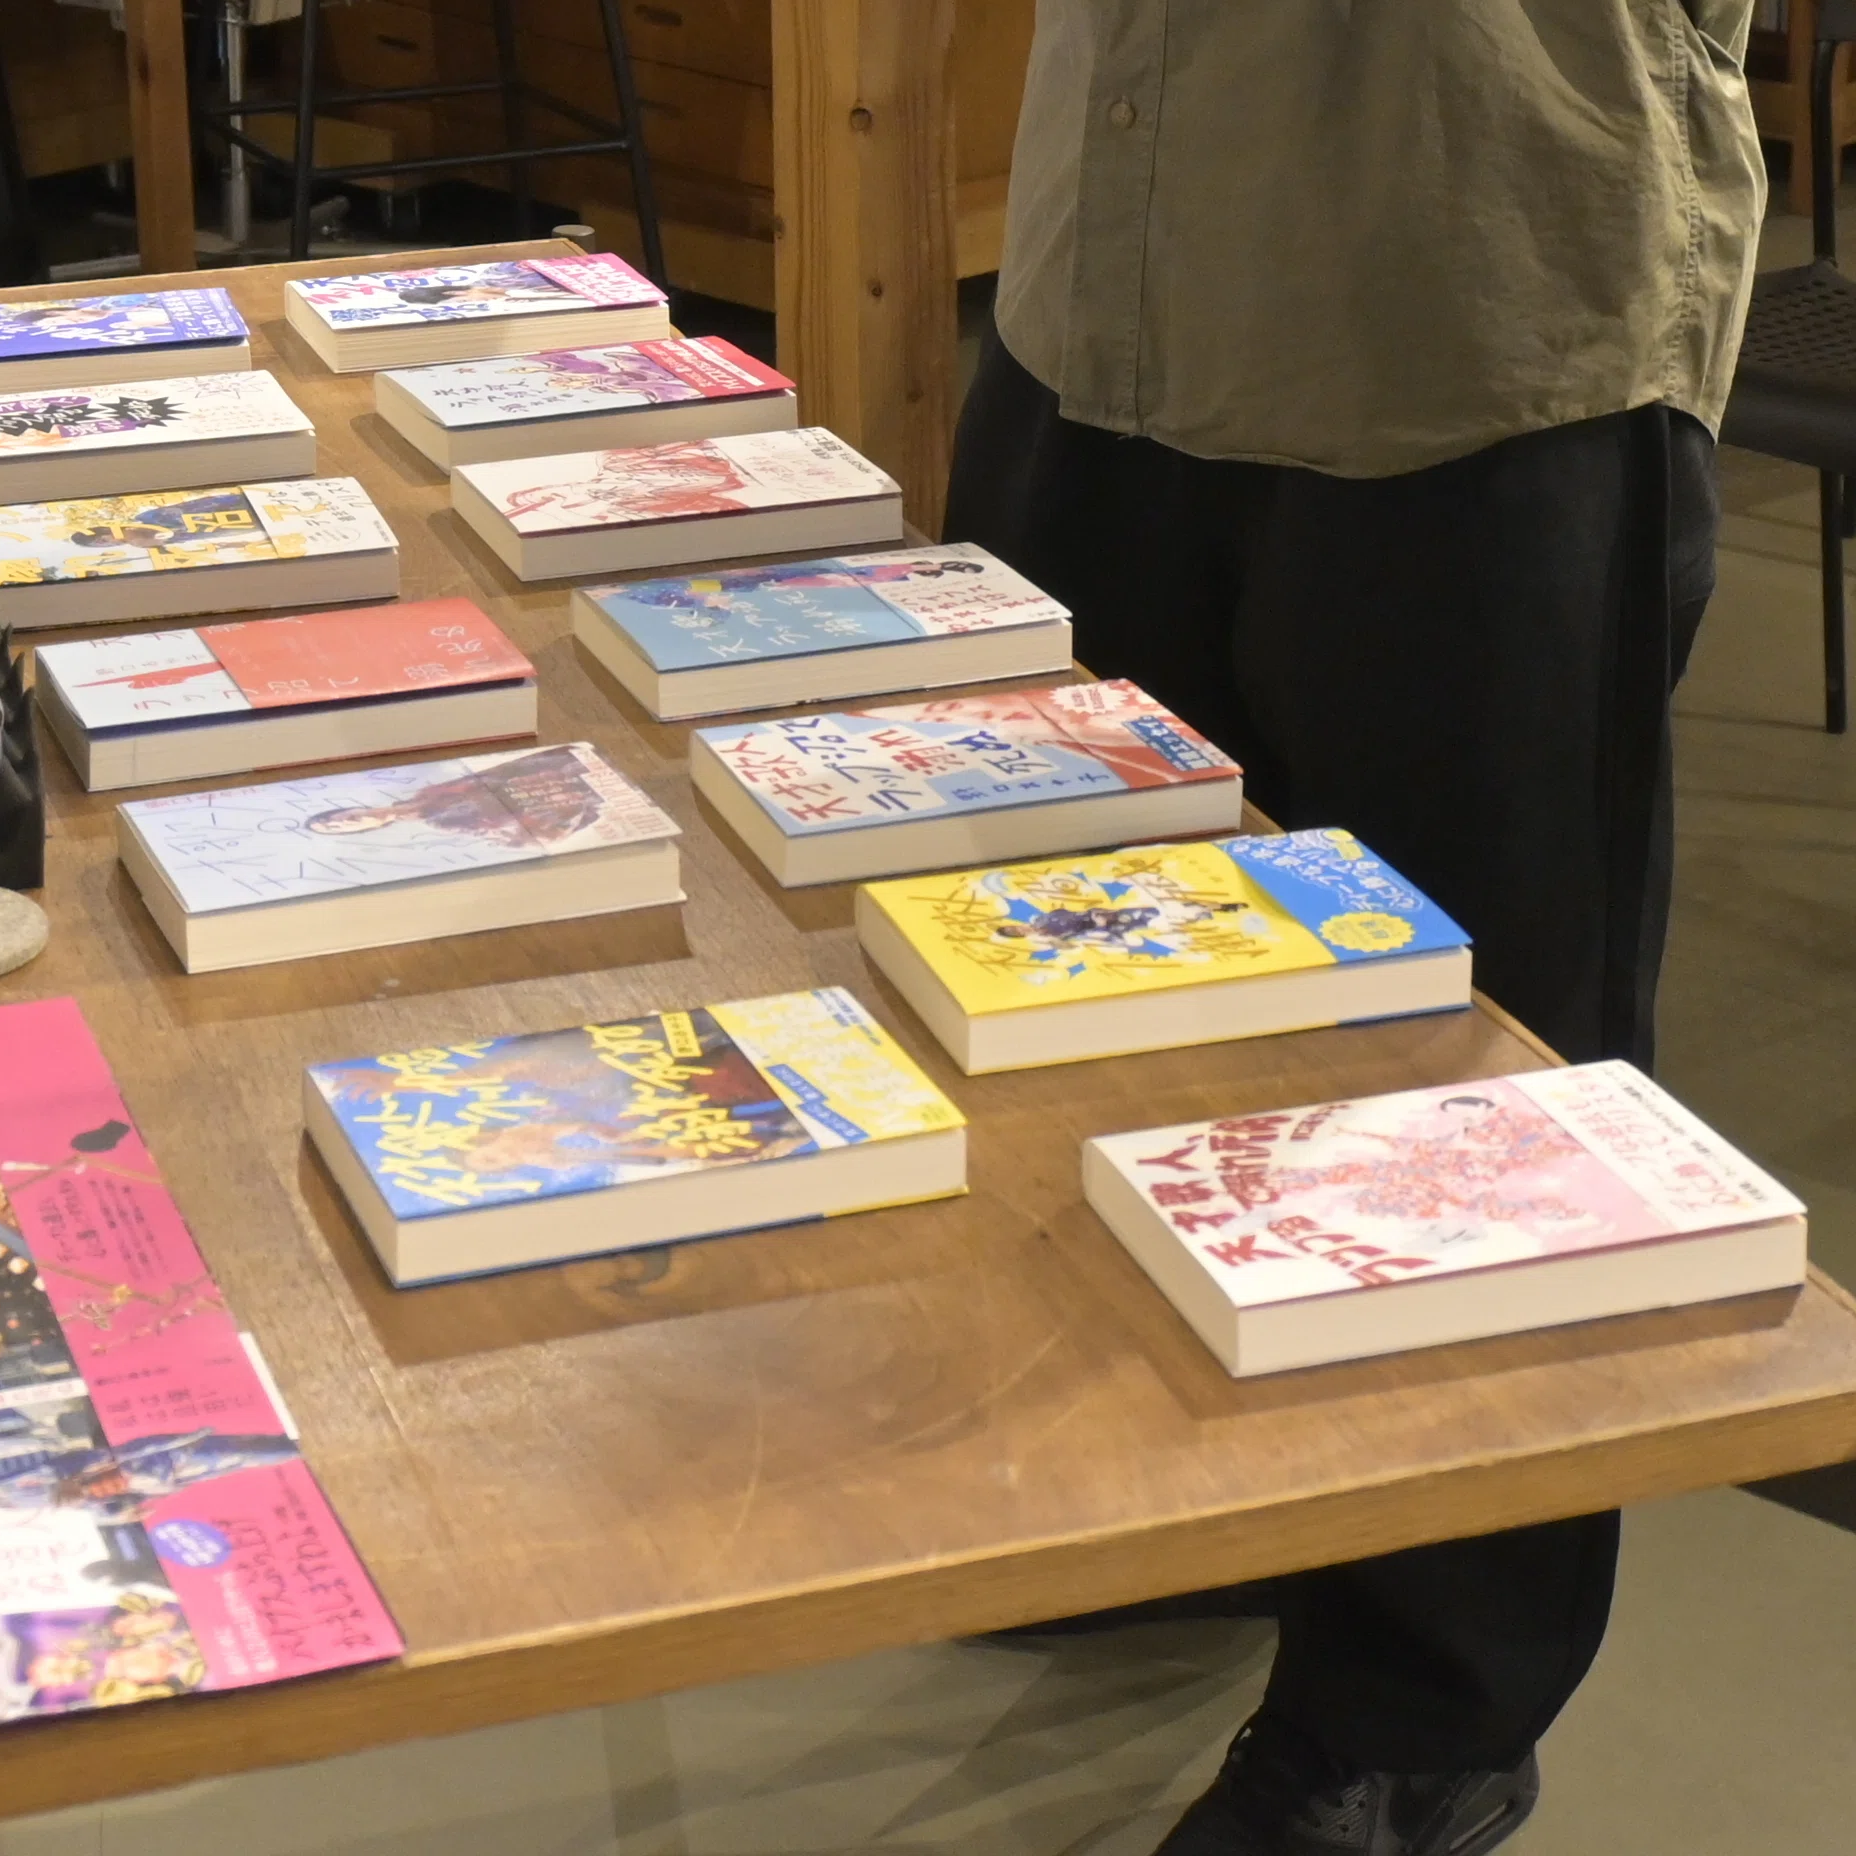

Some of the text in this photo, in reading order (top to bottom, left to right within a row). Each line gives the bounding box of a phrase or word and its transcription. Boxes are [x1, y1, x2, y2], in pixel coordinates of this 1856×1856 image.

[713, 731, 864, 821] 天才歌人、
[775, 717, 922, 813] ラップ沼で
[867, 729, 965, 776] 溺れ
[948, 730, 1051, 774] 死ぬ
[950, 771, 1112, 801] 野口あや子
[581, 1023, 756, 1156] 溺れ死ぬ
[1137, 1134, 1295, 1266] 天才歌人、
